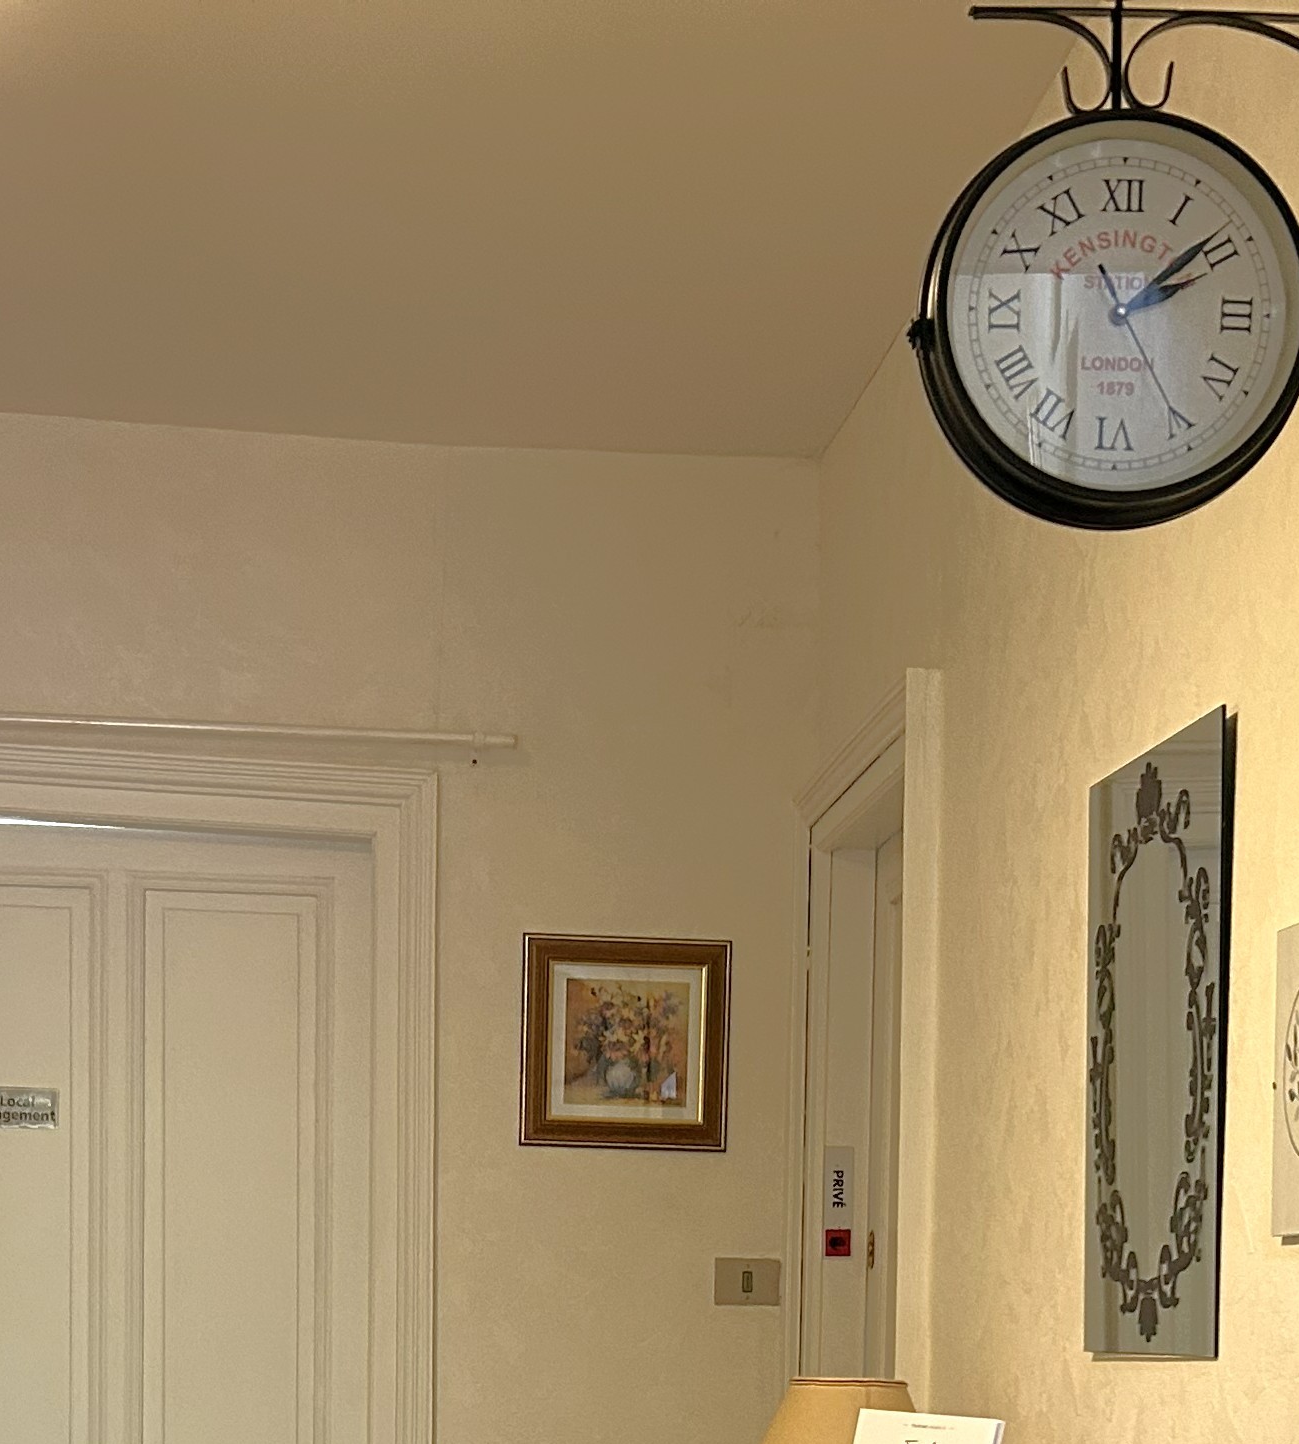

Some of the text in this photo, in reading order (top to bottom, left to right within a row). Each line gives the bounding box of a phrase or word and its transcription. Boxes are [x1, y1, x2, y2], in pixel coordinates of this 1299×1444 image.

[1036, 188, 1086, 237] XI
[1101, 179, 1145, 212] XII
[1167, 193, 1194, 227] I
[1000, 228, 1041, 273] X
[1050, 229, 1197, 290] KENSINGT
[1201, 234, 1240, 272] II
[988, 289, 1021, 334] IX
[1220, 297, 1253, 334] III
[994, 344, 1039, 400] VIII
[1081, 355, 1155, 373] LONDON
[1201, 353, 1239, 401] IV
[1097, 381, 1135, 396] 1879
[1030, 387, 1075, 440] VII
[1094, 416, 1134, 451] VI
[0, 1096, 36, 1108] Local
[833, 1170, 847, 1208] PRIVÉ
